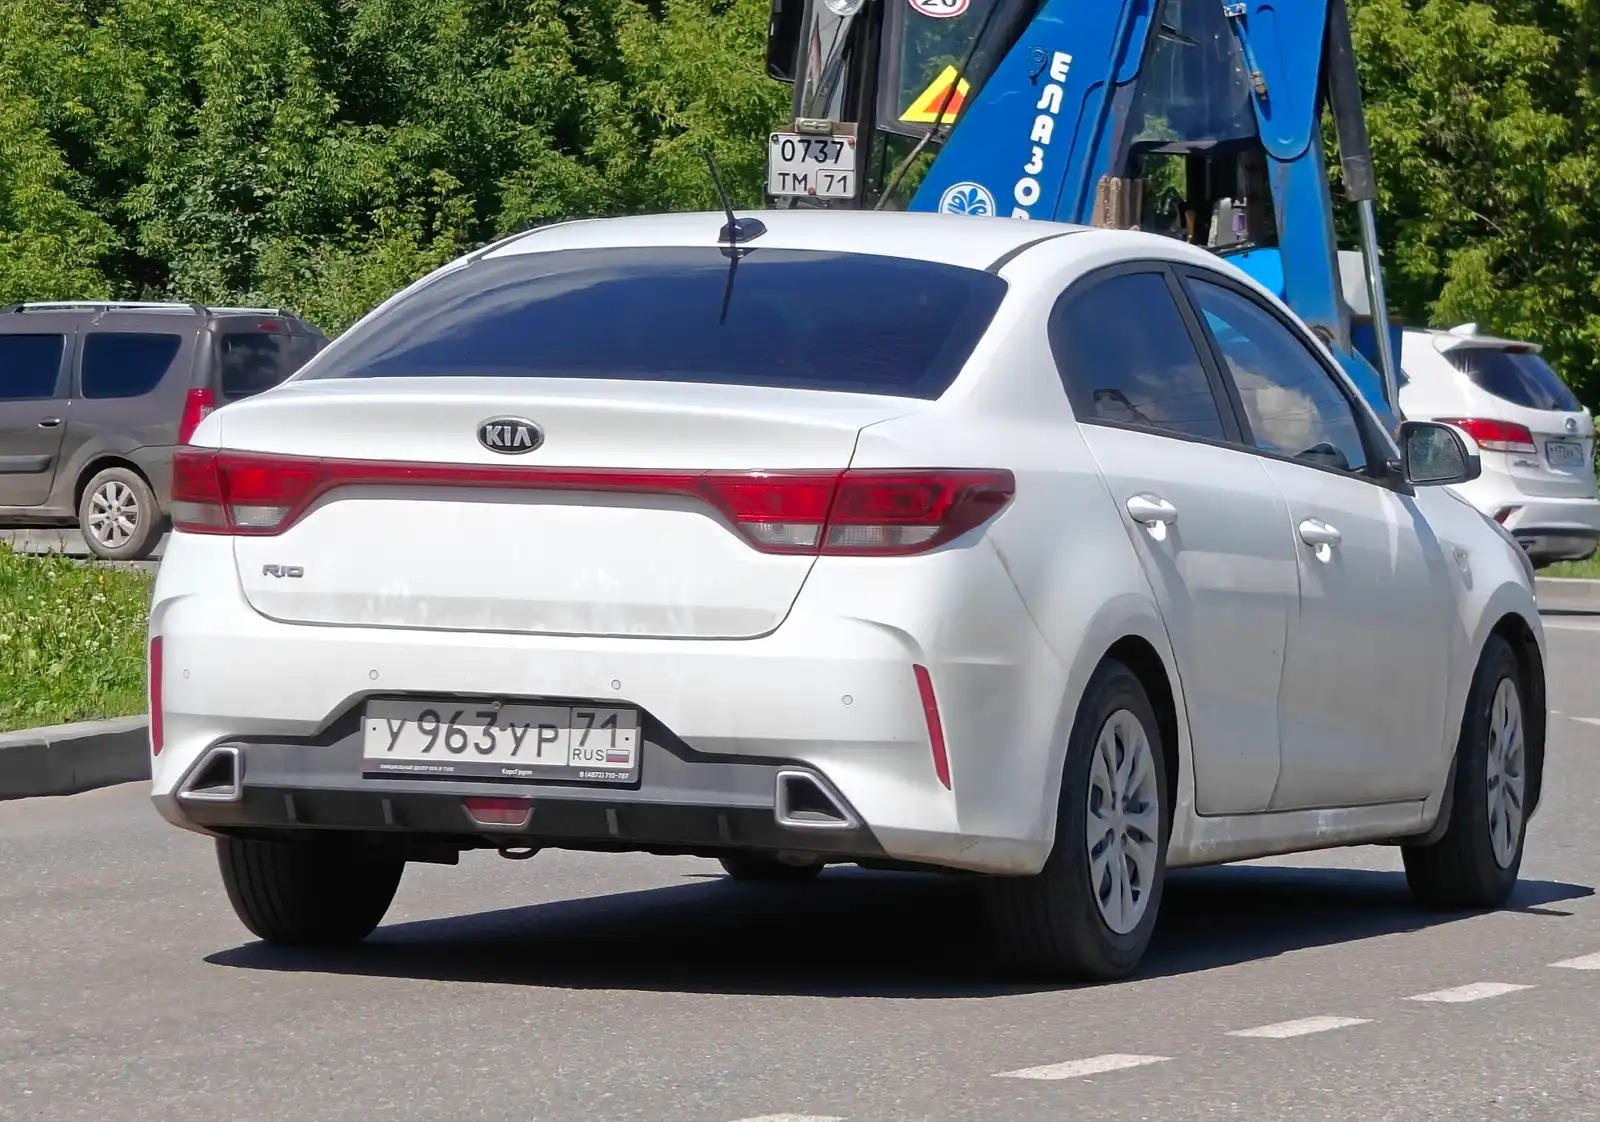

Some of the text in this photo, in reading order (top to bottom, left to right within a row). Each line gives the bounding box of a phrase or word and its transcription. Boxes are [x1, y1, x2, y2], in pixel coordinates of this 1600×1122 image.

[780, 139, 845, 165] 0737
[777, 172, 848, 193] ТМ 71
[485, 425, 533, 447] KIA
[262, 564, 305, 578] RIO
[576, 712, 618, 748] 71
[572, 748, 605, 761] RUS
